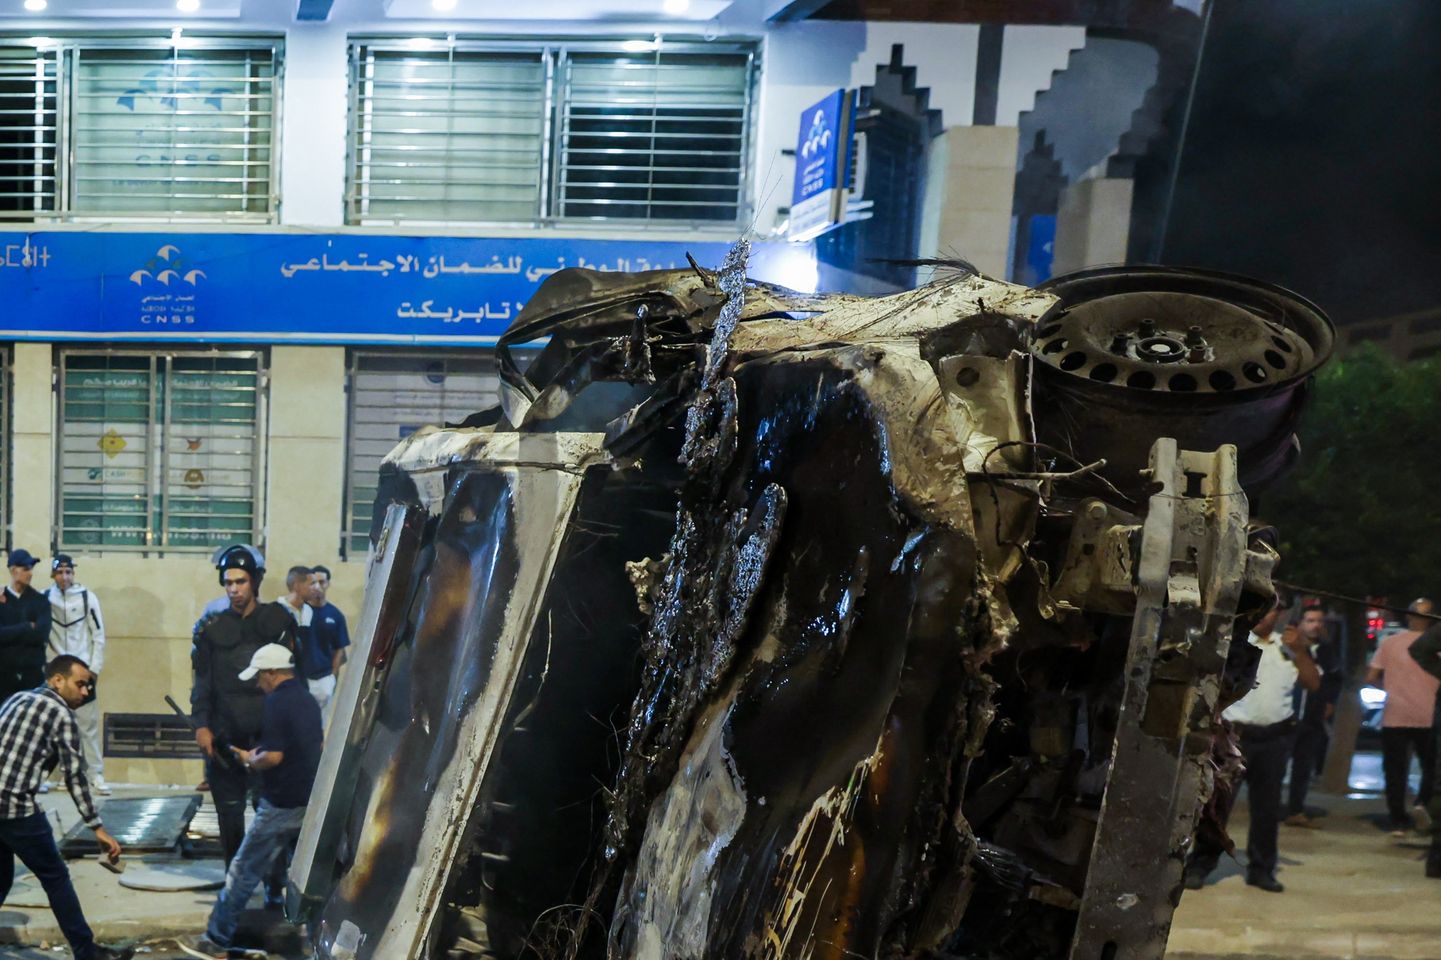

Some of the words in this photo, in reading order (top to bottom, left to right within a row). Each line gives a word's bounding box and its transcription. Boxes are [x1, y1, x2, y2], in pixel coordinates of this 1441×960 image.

[280, 252, 420, 278] الاجتماعي
[422, 254, 523, 280] للضمان
[140, 314, 196, 324] CNSS
[396, 299, 511, 323] تابريكت
